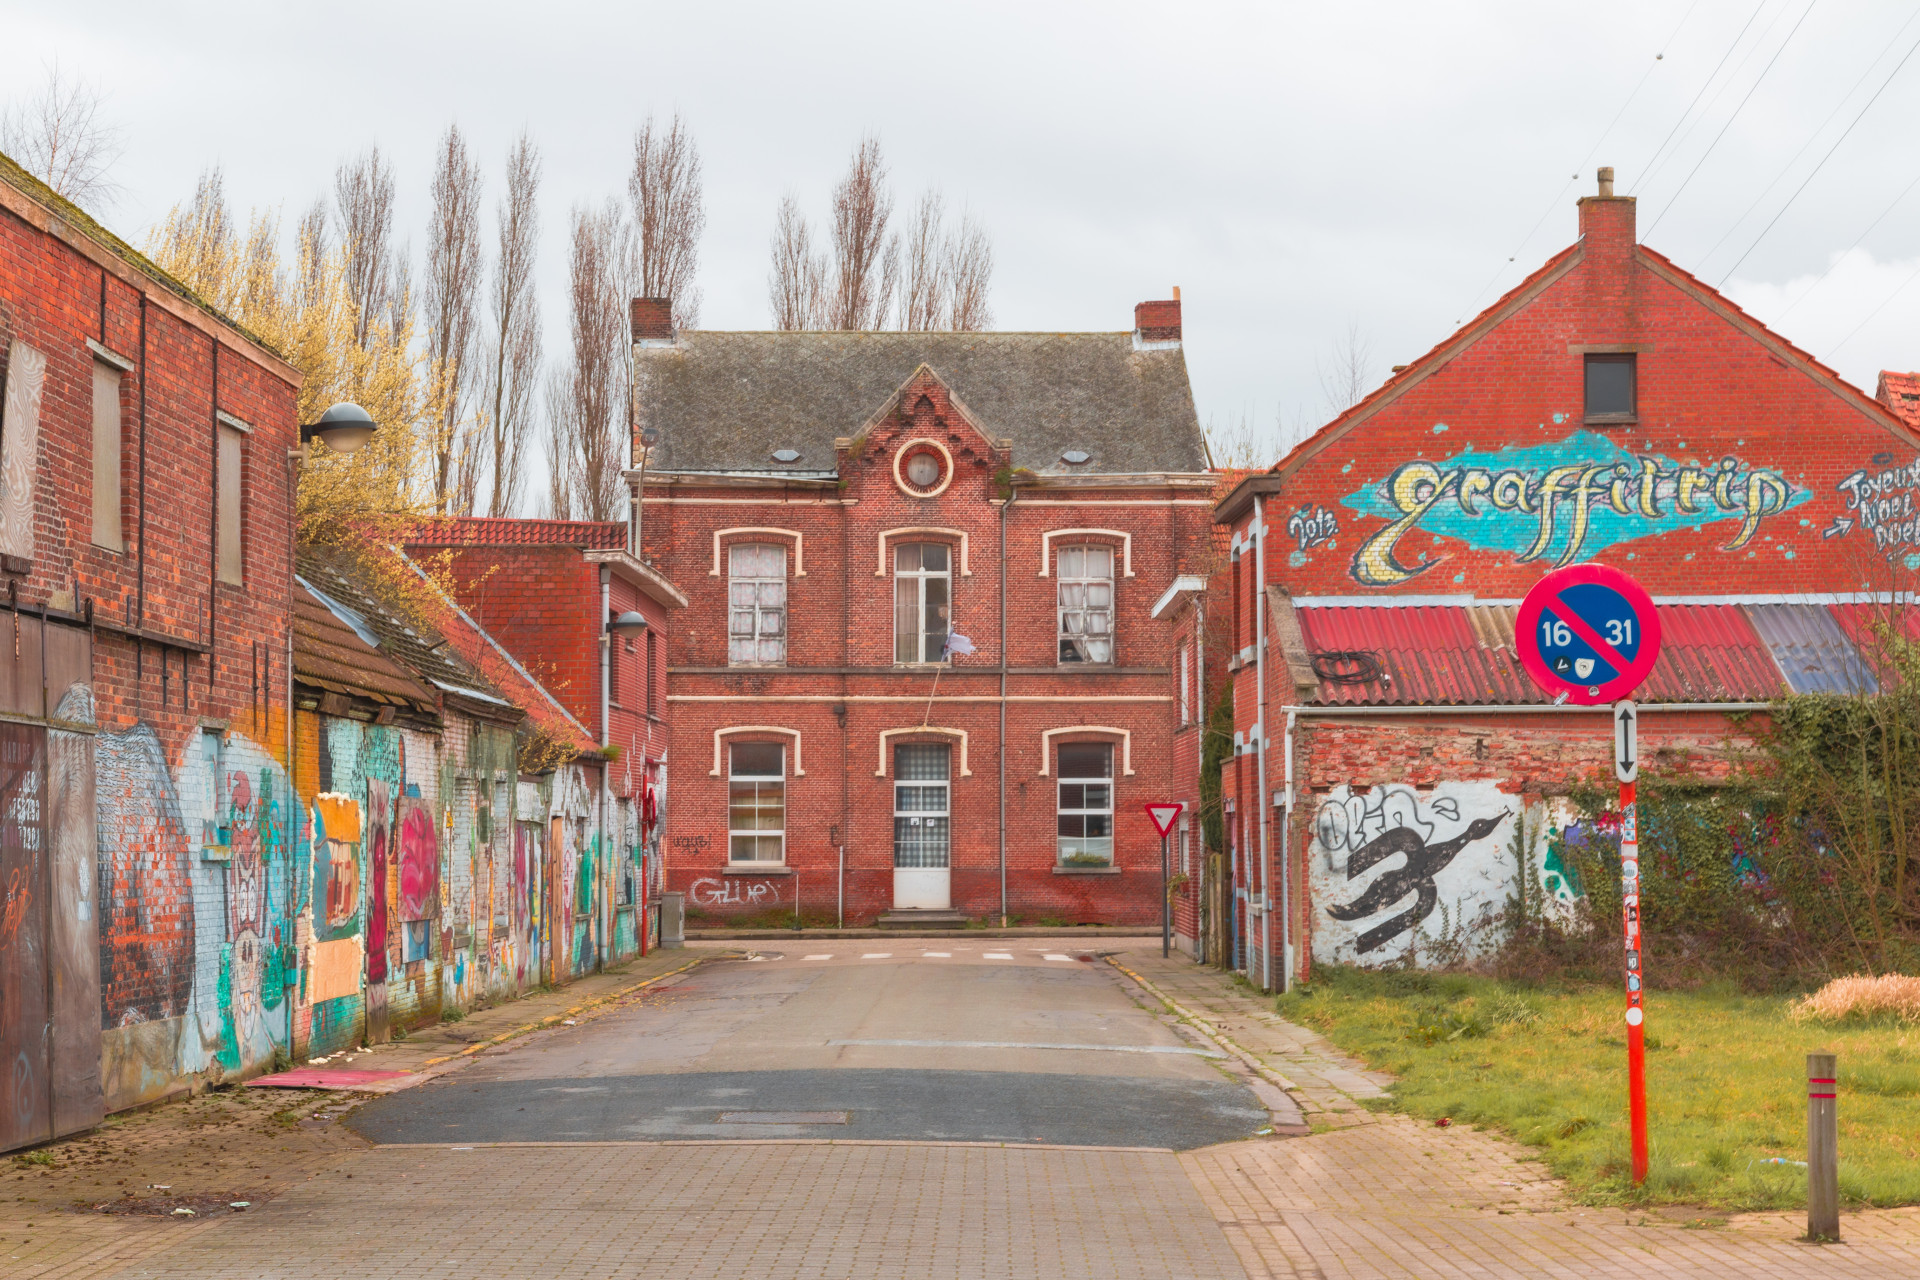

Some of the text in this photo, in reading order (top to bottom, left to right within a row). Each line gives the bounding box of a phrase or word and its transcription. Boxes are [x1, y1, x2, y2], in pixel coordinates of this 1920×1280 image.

[1349, 455, 1797, 586] graffitrip
[1542, 619, 1632, 647] 16 31
